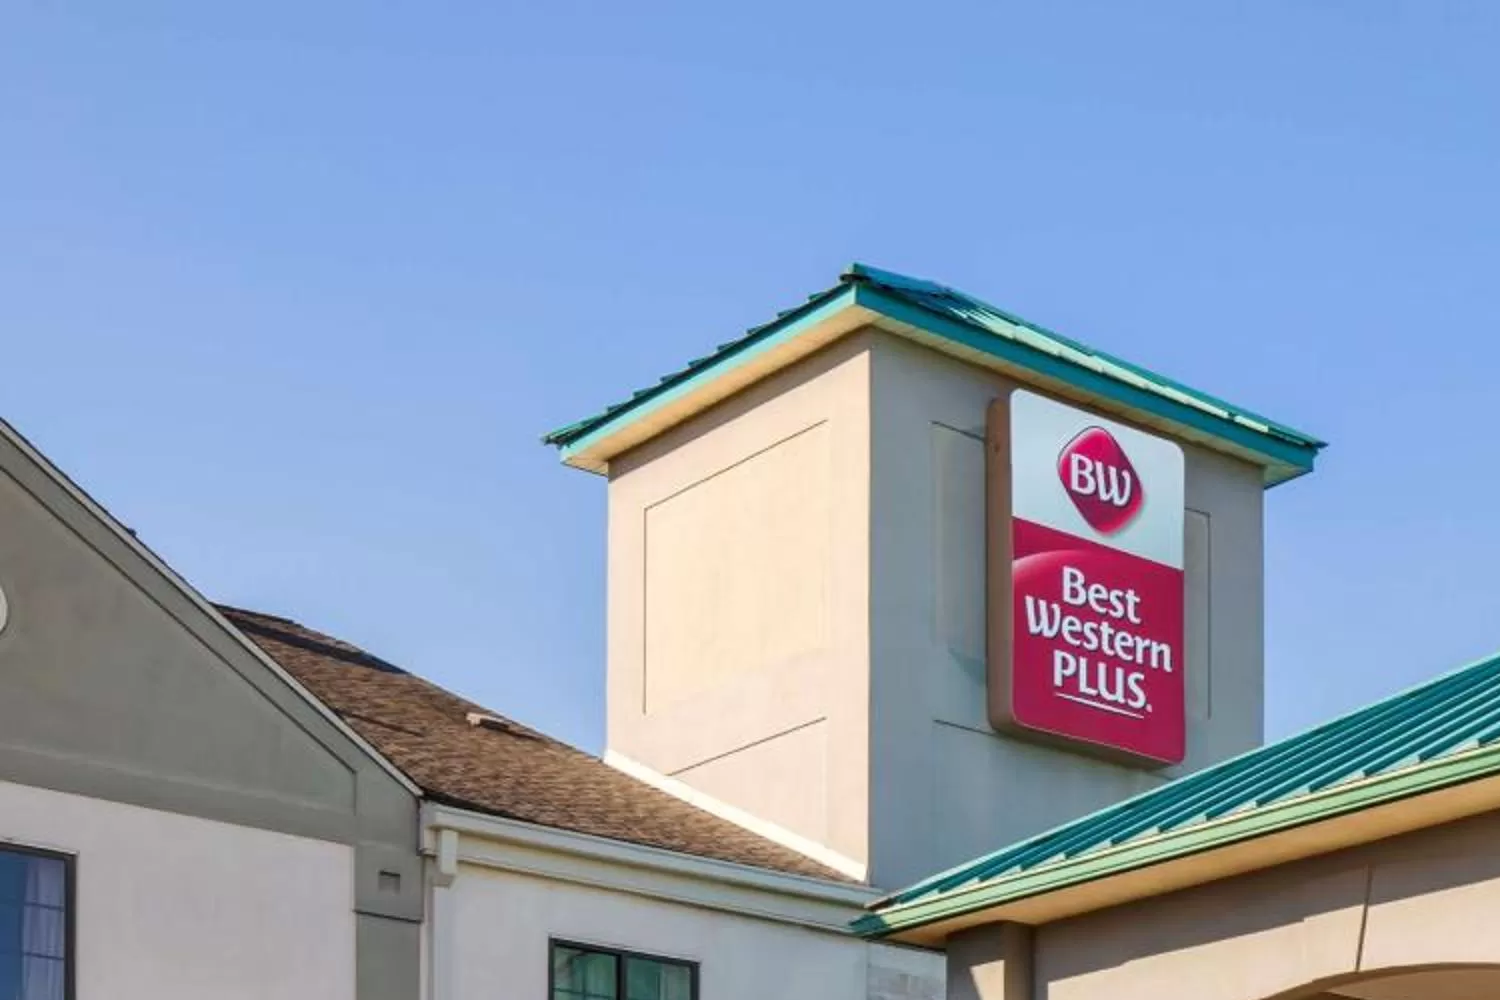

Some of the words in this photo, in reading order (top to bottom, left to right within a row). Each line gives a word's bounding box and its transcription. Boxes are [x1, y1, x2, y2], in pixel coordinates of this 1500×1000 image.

[1070, 453, 1132, 506] BW
[1062, 566, 1141, 624] Best
[1025, 595, 1172, 672] Western
